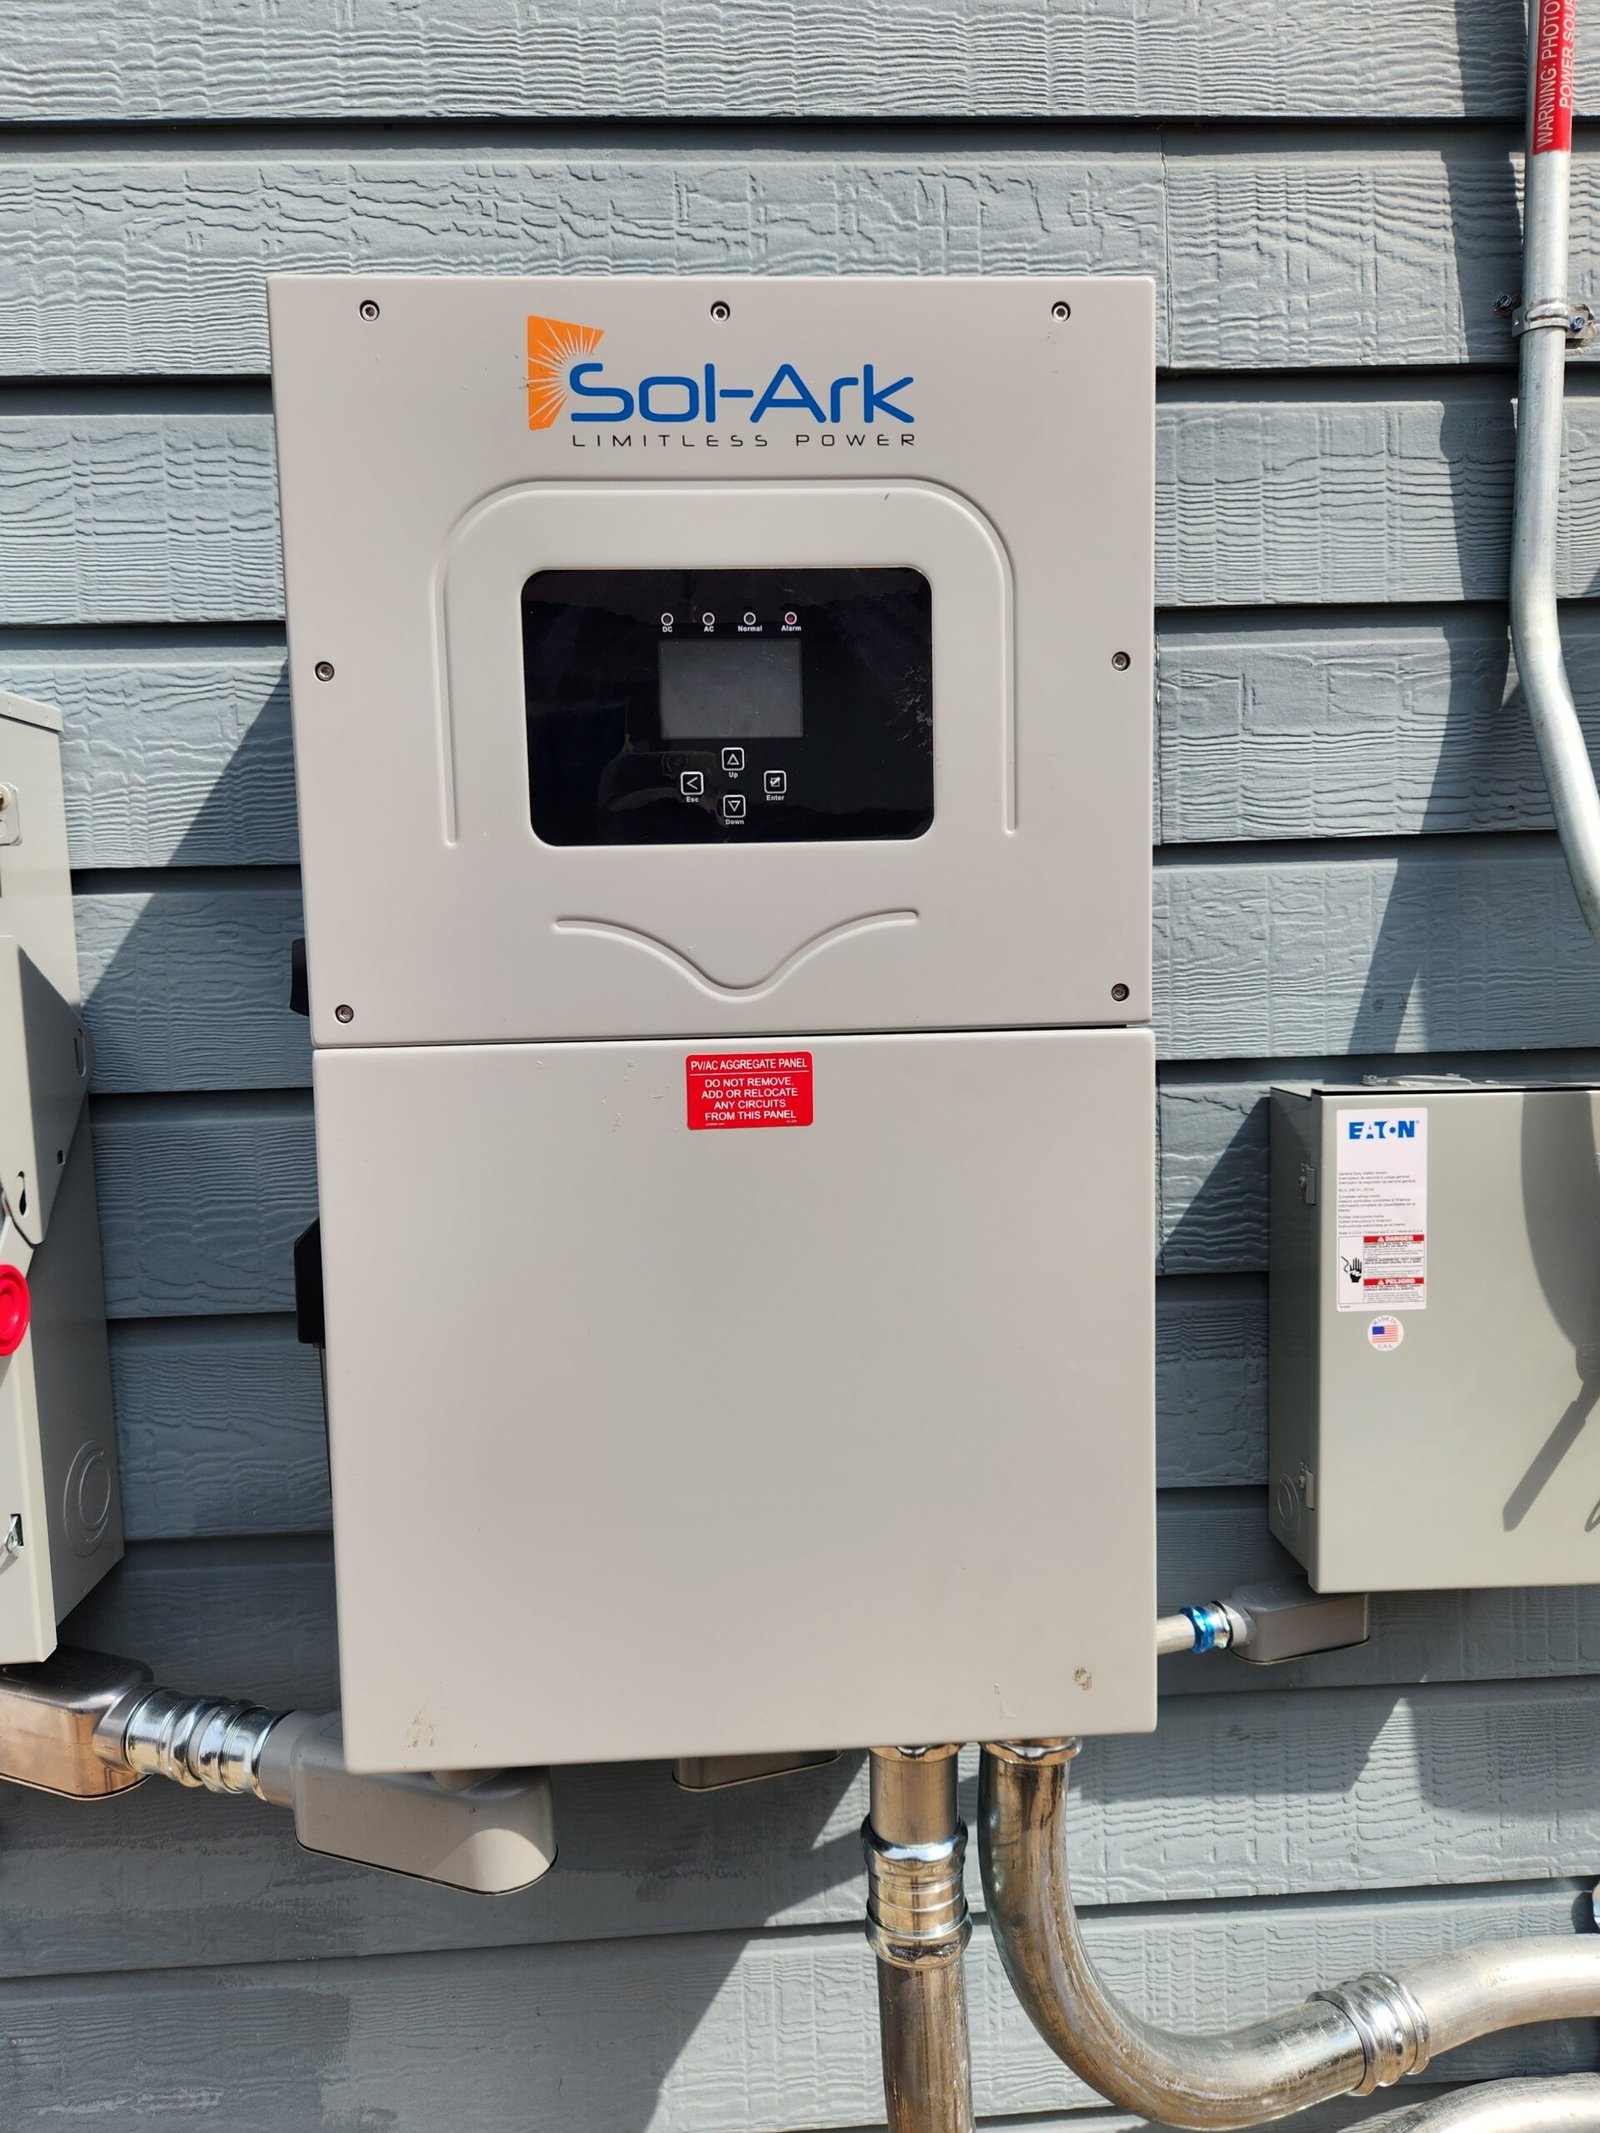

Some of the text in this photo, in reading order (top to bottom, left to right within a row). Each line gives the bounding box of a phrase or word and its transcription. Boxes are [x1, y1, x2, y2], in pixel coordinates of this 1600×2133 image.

[1537, 0, 1561, 148] WARNING: PHOTO
[1560, 46, 1574, 109] POWER
[569, 362, 915, 425] Sol-Ark
[572, 433, 915, 448] LIMITLESS POWER
[690, 1057, 807, 1071] PV/AC AGGREGATE PANEL
[705, 1076, 795, 1088] DO NOT REMOVE,
[701, 1087, 798, 1099] ADD OR RELOCATE
[714, 1099, 787, 1110] ANY CIRCUITS
[704, 1109, 797, 1121] FROM THIS PANEL
[1348, 1120, 1415, 1140] EATON
